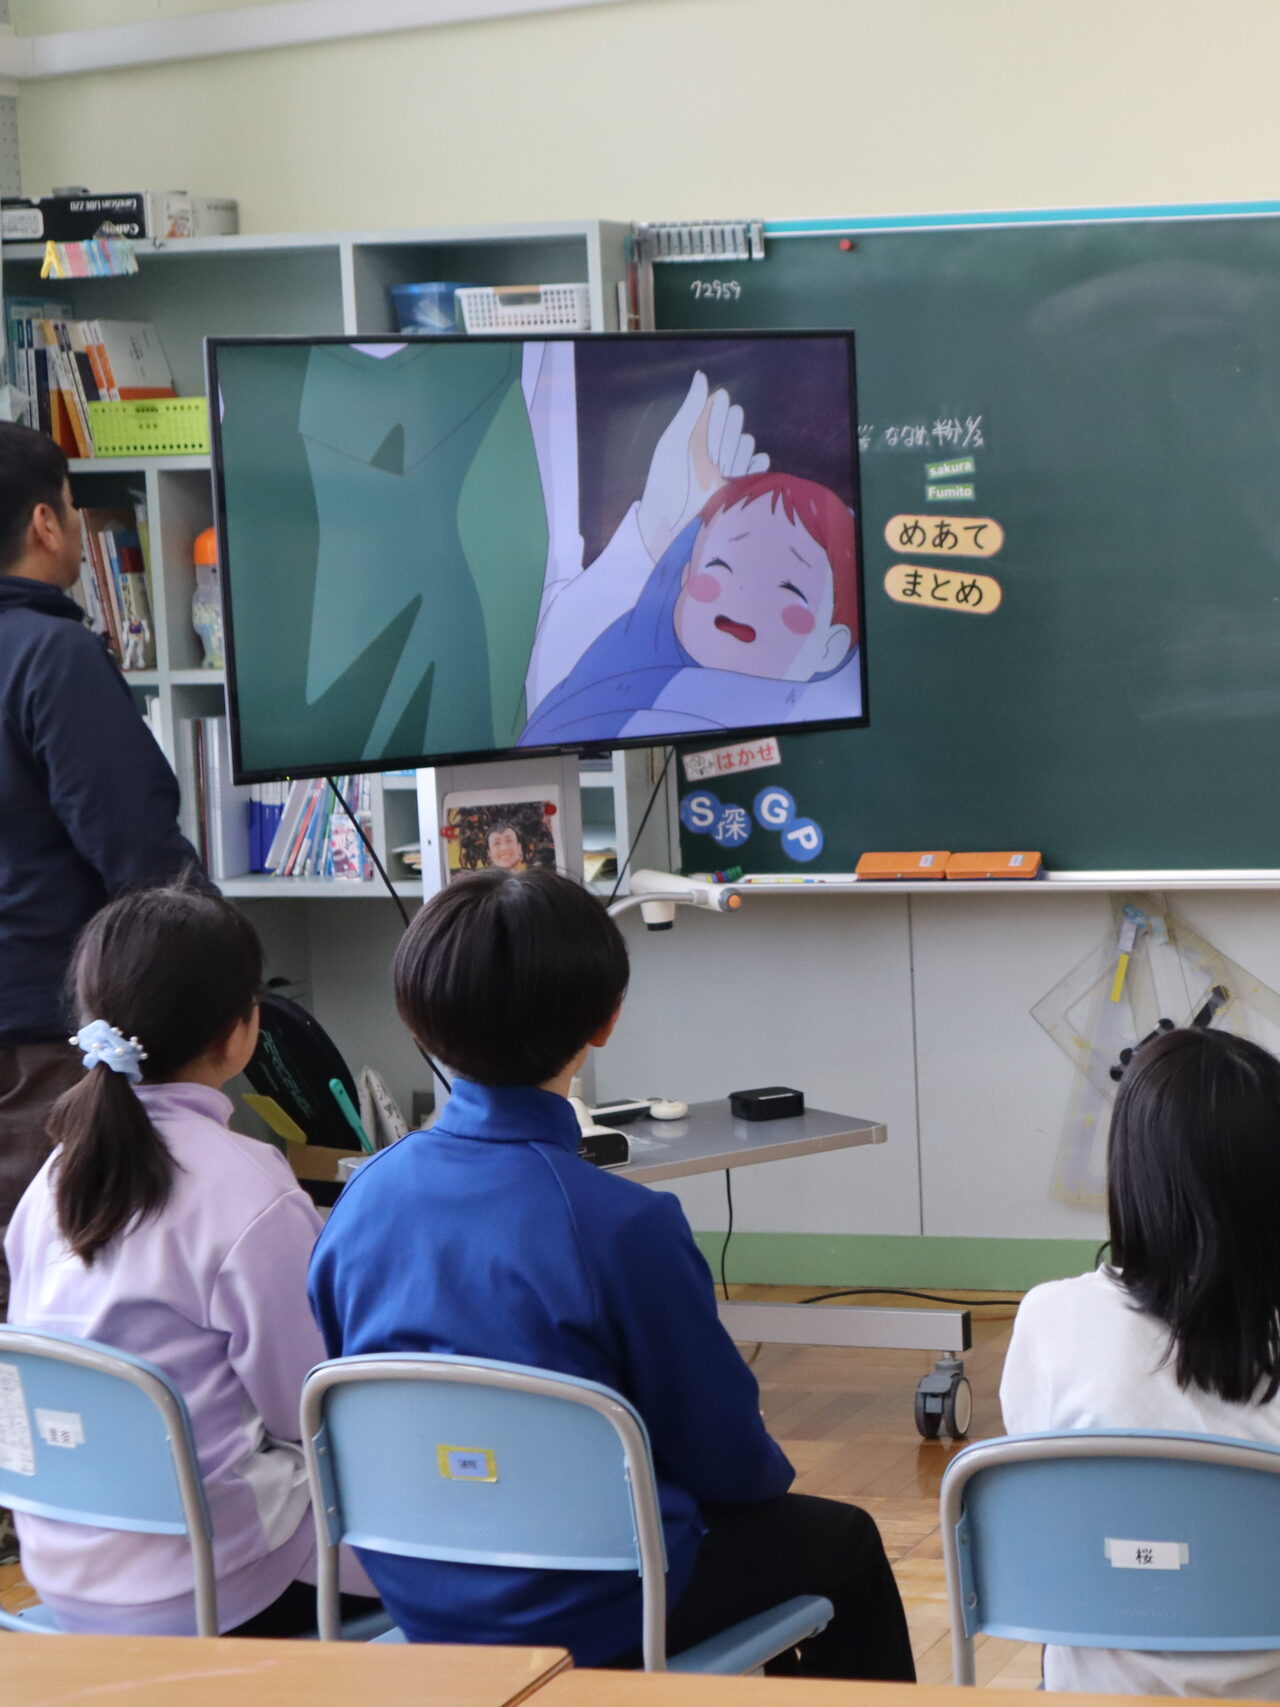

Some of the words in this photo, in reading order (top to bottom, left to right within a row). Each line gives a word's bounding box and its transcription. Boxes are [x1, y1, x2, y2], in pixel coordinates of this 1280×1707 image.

[690, 279, 741, 300] 72959
[929, 461, 972, 477] sakura
[928, 485, 972, 498] Fumito
[899, 519, 988, 550] めあて
[902, 569, 983, 607] まとめ
[716, 743, 774, 771] はかせ
